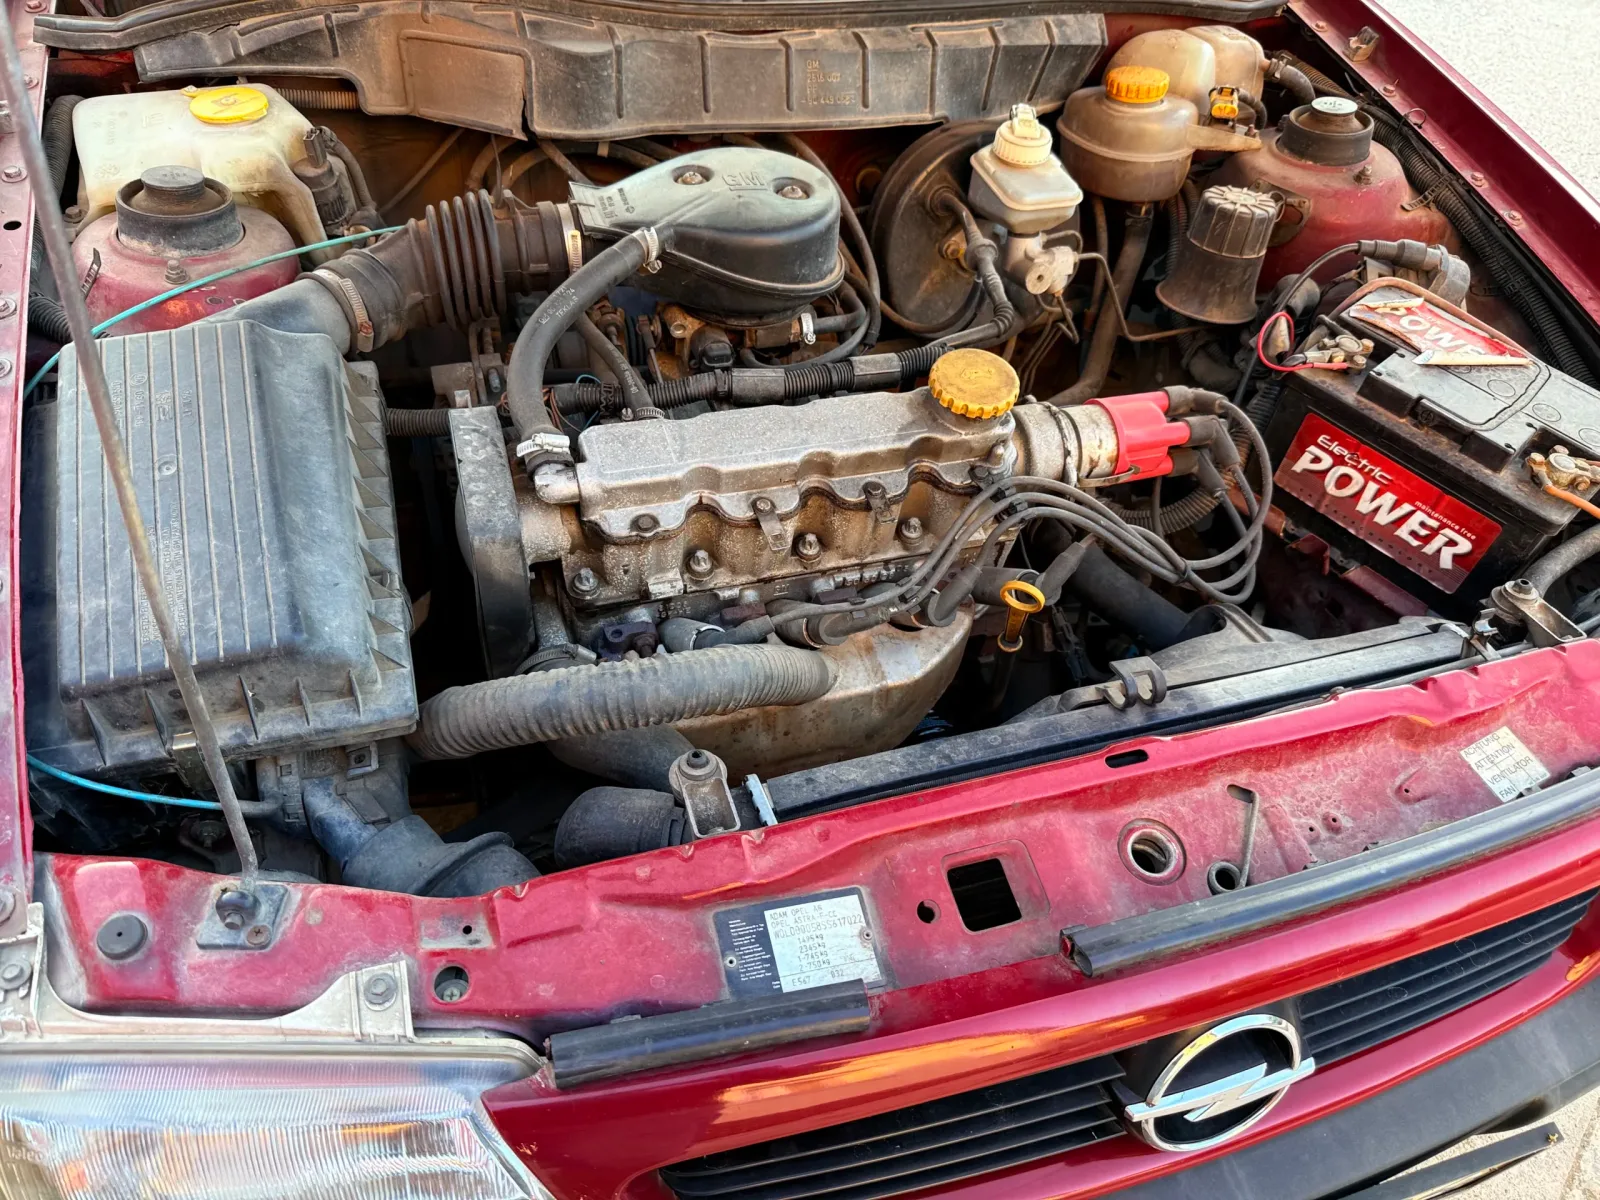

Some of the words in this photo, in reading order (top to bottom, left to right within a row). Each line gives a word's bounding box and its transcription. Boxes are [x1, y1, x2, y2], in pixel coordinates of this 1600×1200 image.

[722, 170, 768, 190] GM
[1317, 434, 1393, 484] Electric
[1290, 444, 1473, 570] POWER
[1414, 500, 1461, 531] maintenance
[1460, 527, 1477, 540] free
[1463, 732, 1500, 757] ACHTUNG
[1474, 742, 1516, 770] ATTENTION
[1487, 755, 1534, 785] VENTILATOR
[1499, 786, 1516, 799] FAN
[769, 910, 788, 921] ADAM
[791, 907, 809, 918] OPEL
[771, 917, 790, 928] OPEL
